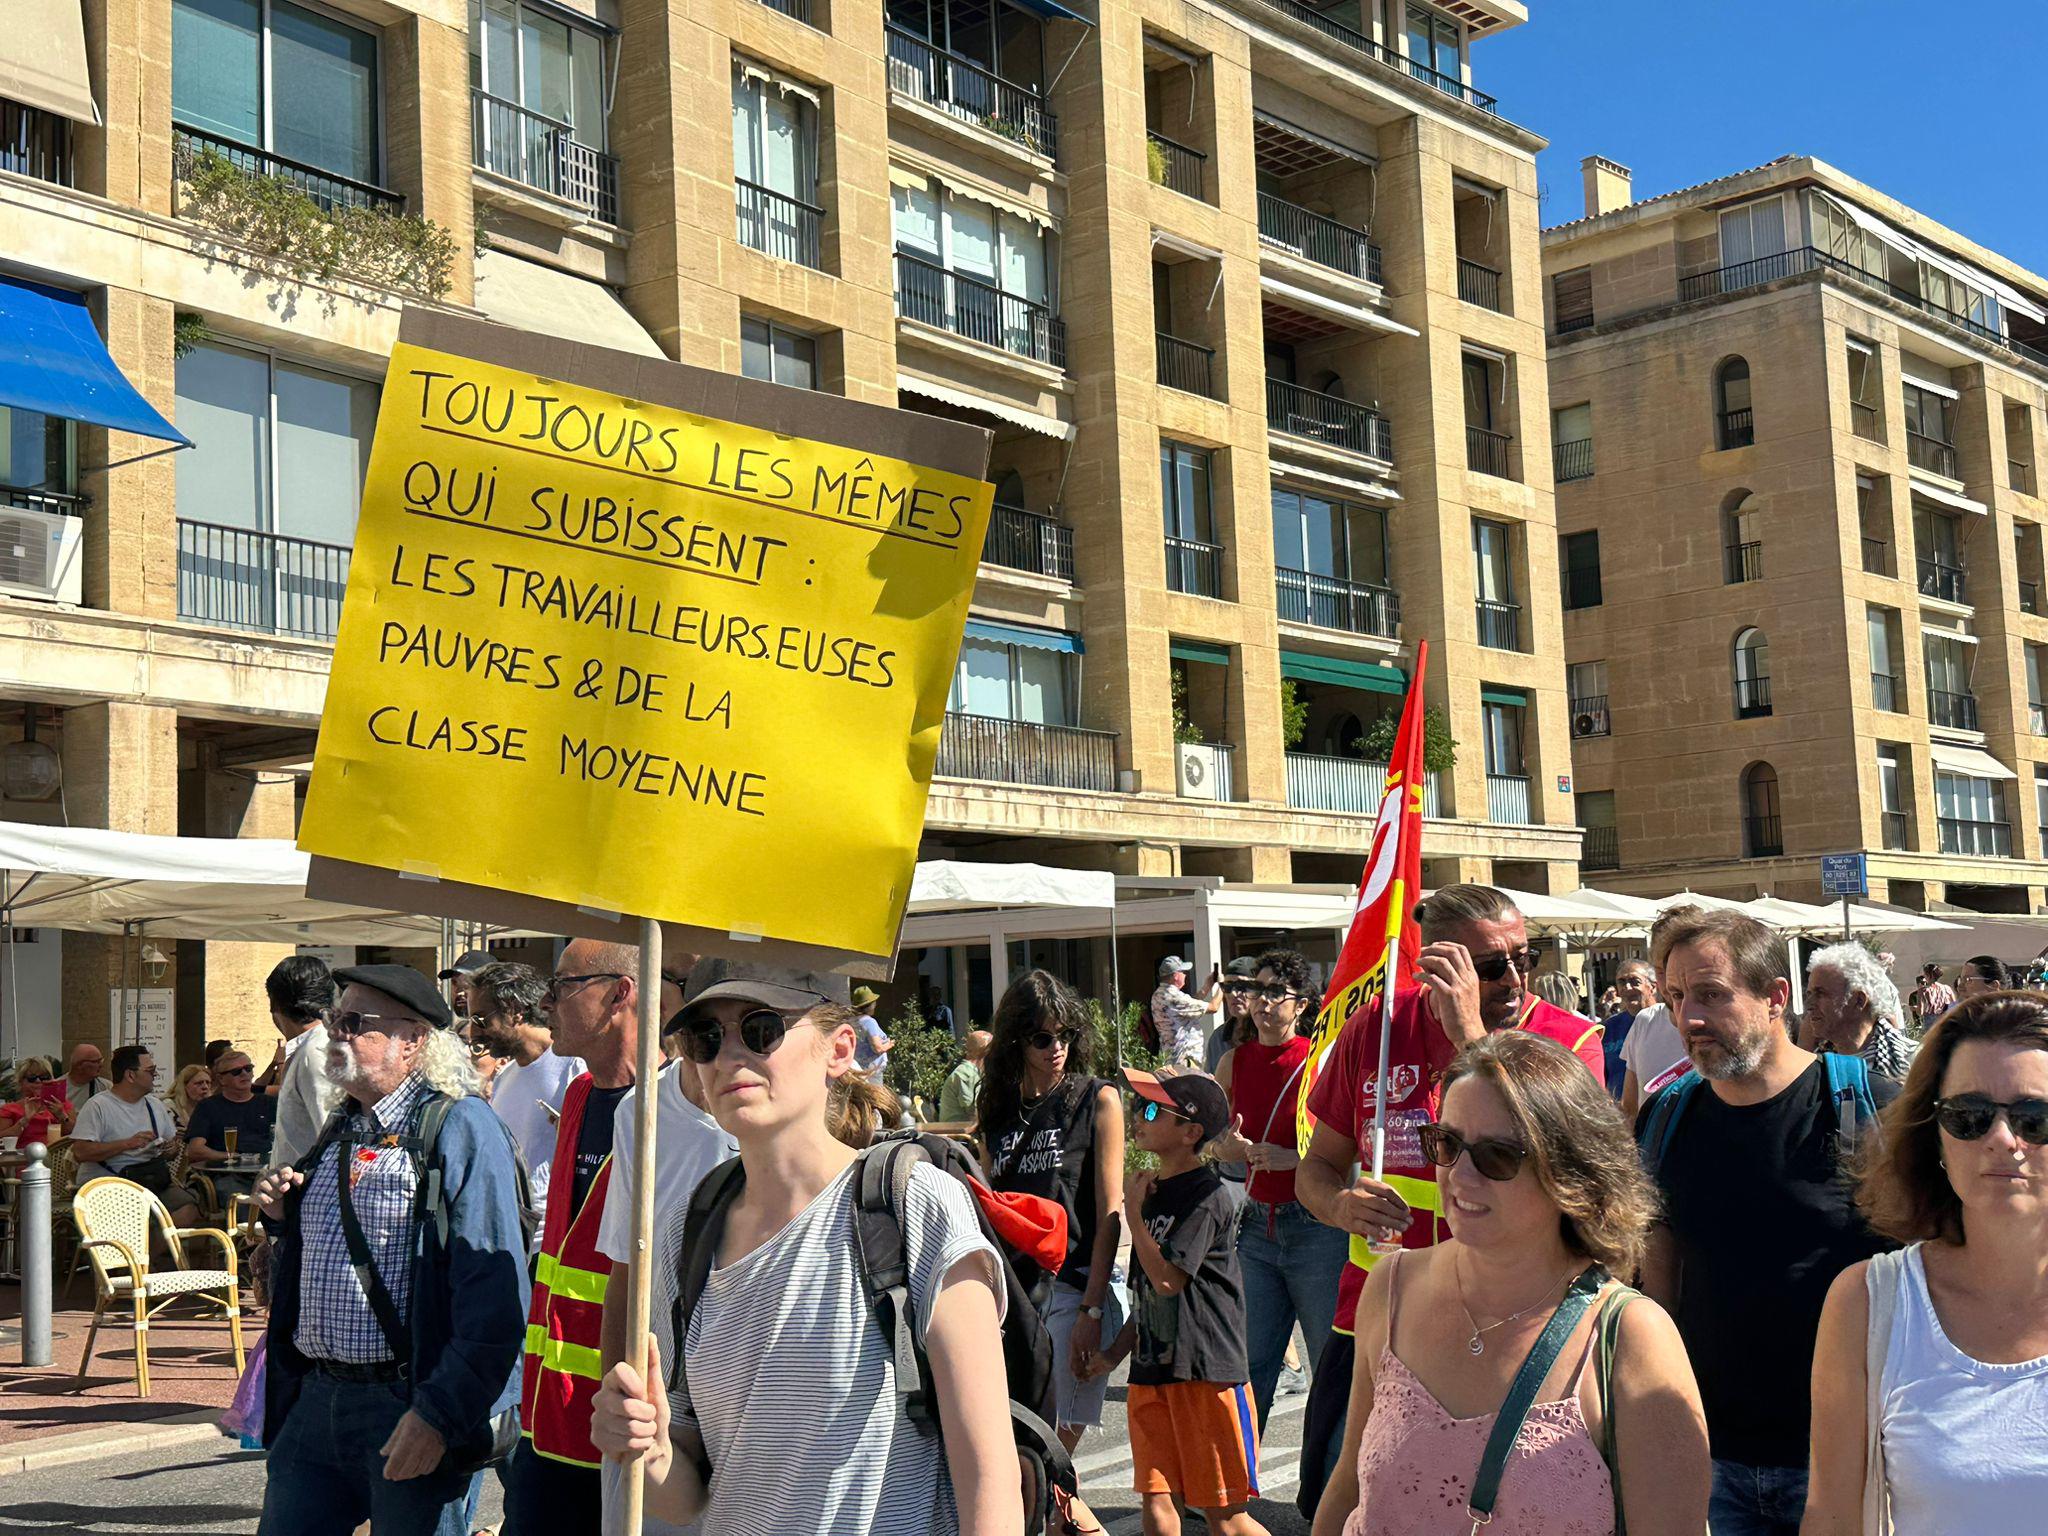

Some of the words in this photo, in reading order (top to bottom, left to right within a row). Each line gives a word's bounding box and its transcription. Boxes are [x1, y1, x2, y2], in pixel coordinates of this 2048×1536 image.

[410, 370, 679, 473] TOUJOURS
[708, 442, 794, 499] LES
[811, 457, 971, 539] MÊMES
[391, 545, 475, 597] LES
[379, 621, 562, 690] PAUVRES
[573, 659, 603, 700] &
[615, 665, 668, 713] DE
[684, 682, 731, 729] LA
[367, 706, 528, 762] CLASSE
[560, 733, 766, 817] MOYENNE
